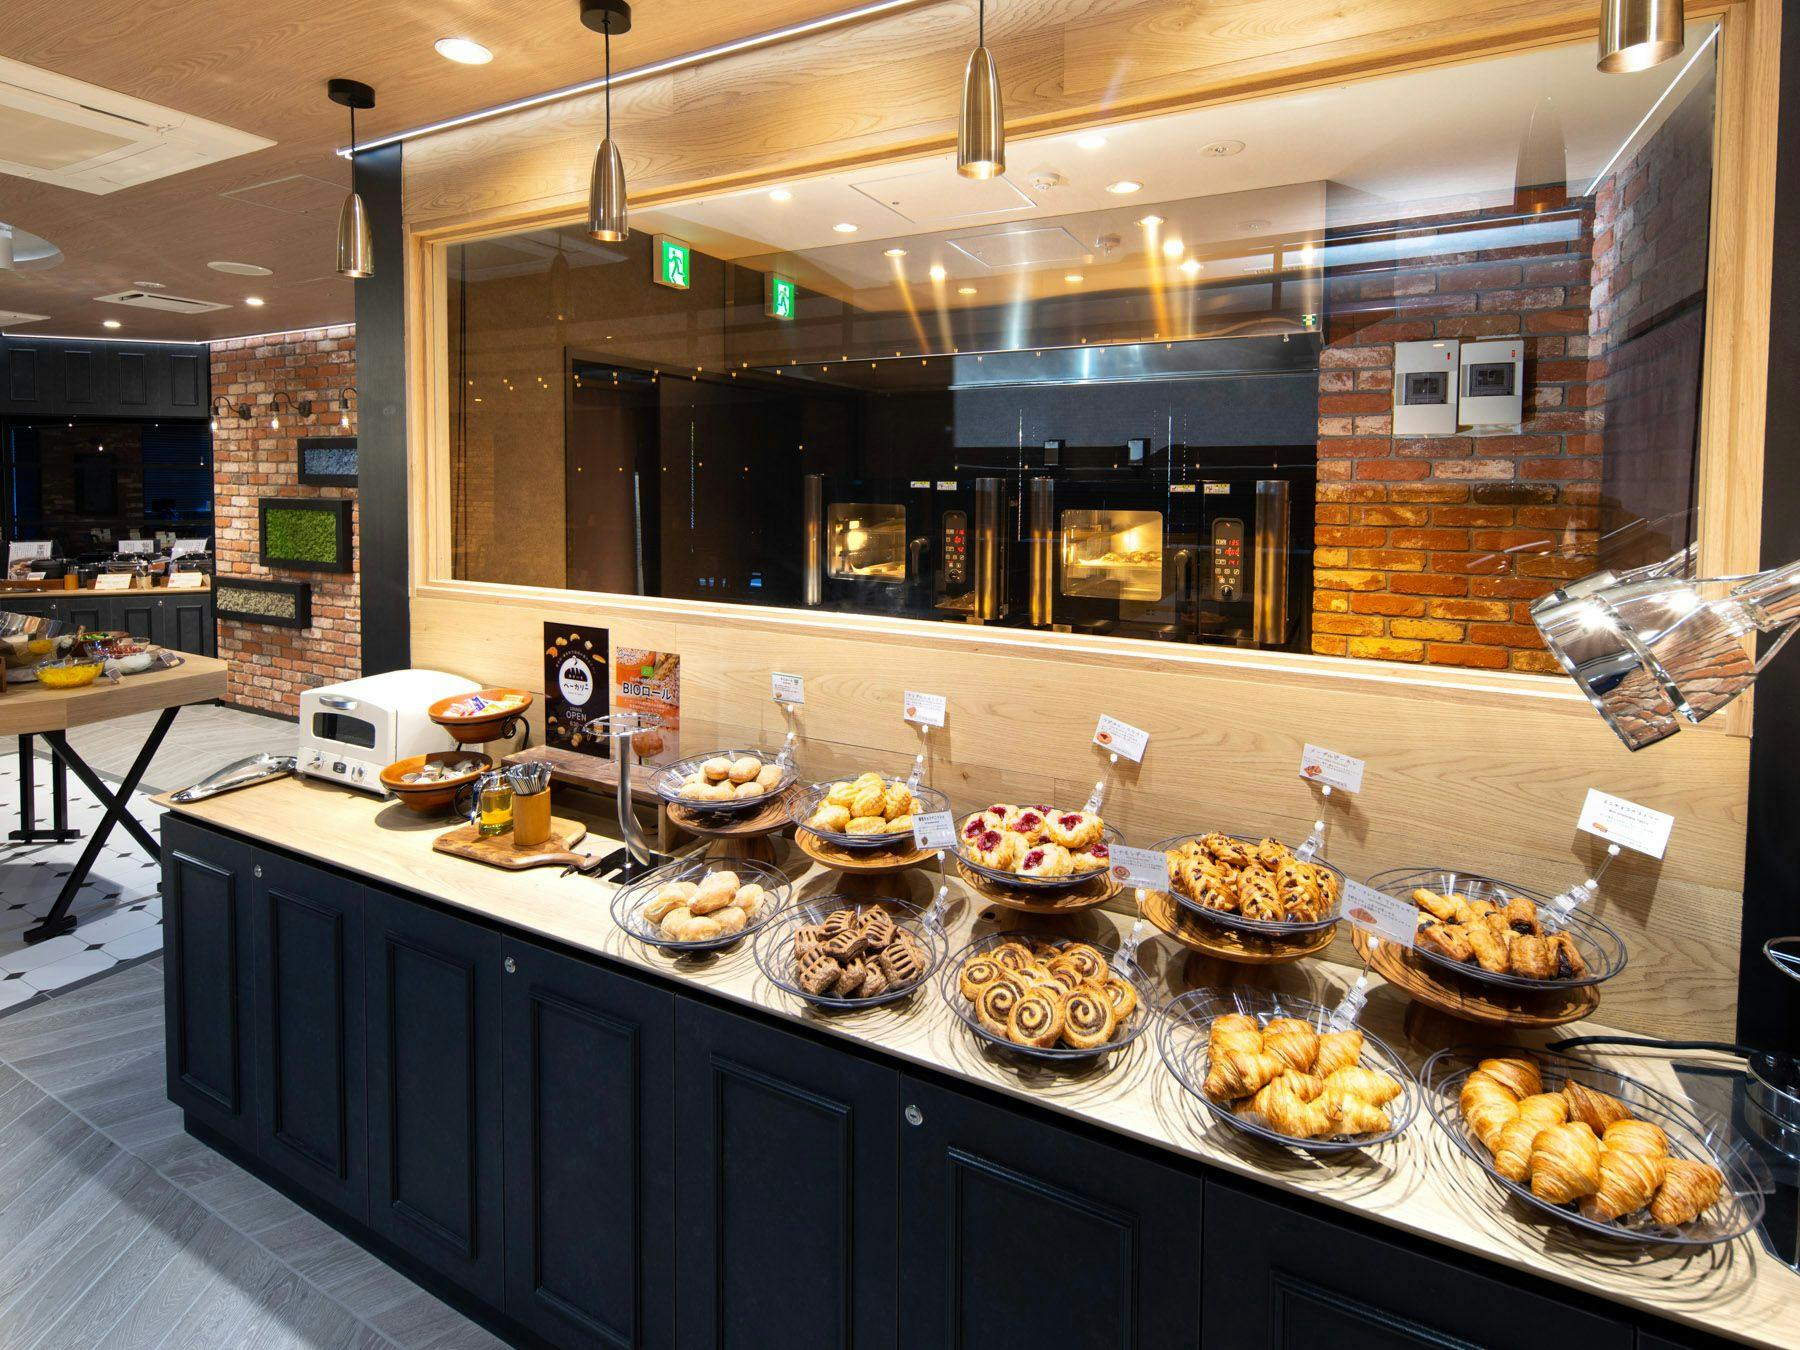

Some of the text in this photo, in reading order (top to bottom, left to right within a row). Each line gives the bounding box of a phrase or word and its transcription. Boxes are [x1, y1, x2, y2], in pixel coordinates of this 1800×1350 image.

[623, 682, 671, 699] BIOロール
[566, 711, 586, 721] OPEN
